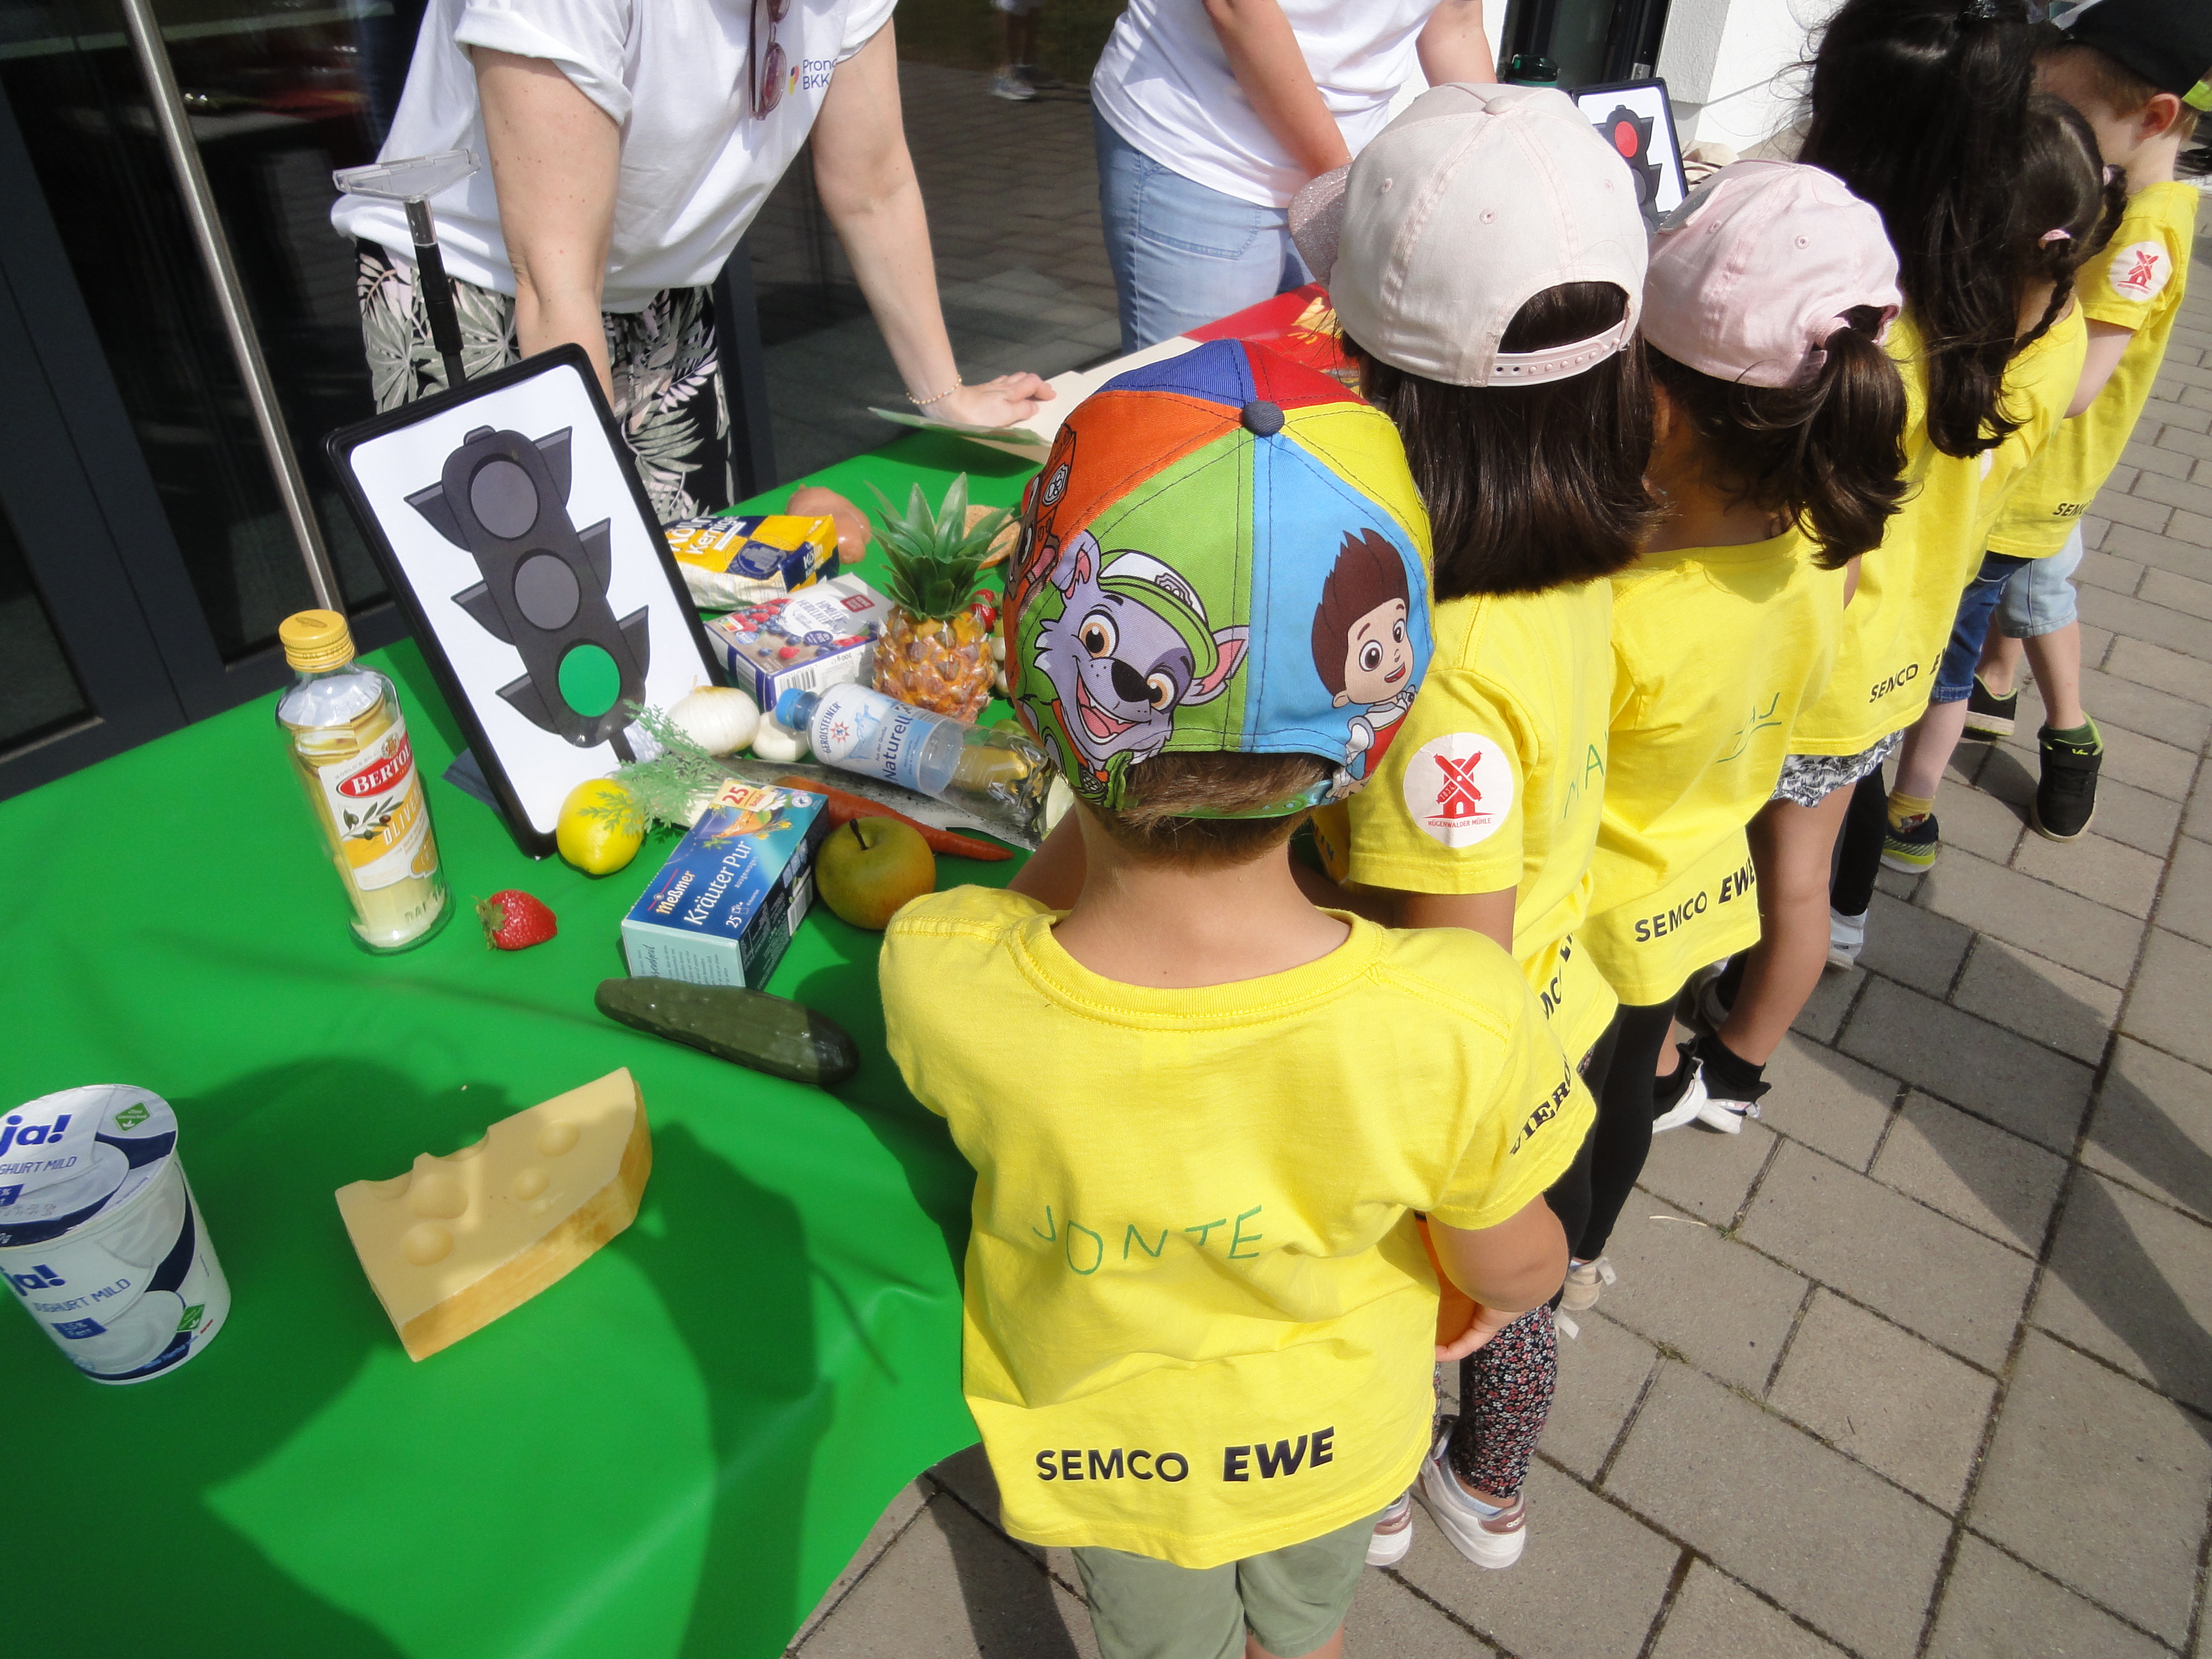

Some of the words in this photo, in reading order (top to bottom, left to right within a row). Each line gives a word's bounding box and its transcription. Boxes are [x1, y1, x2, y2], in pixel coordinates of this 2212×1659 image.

[802, 73, 830, 90] BKK
[820, 702, 842, 754] GEROLSTEINER
[883, 715, 913, 781] Naturell
[722, 786, 749, 805] 25
[1439, 785, 1455, 800] 1834
[1428, 820, 1470, 828] RÜGENWALDER
[655, 870, 695, 915] Meßmer
[684, 866, 735, 926] Kräuter
[723, 841, 753, 868] Pur
[734, 855, 759, 888] ausgewogen
[726, 914, 742, 928] 25
[1635, 891, 1708, 942] SEMCO
[1509, 1053, 1571, 1155] VIERO
[0, 1114, 72, 1157] ja!
[43, 1156, 77, 1171] MILD
[1032, 1205, 1262, 1275] JONTE
[90, 1278, 132, 1302] MILD
[1035, 1448, 1189, 1483] SEMCO
[1223, 1426, 1335, 1482] EWE
